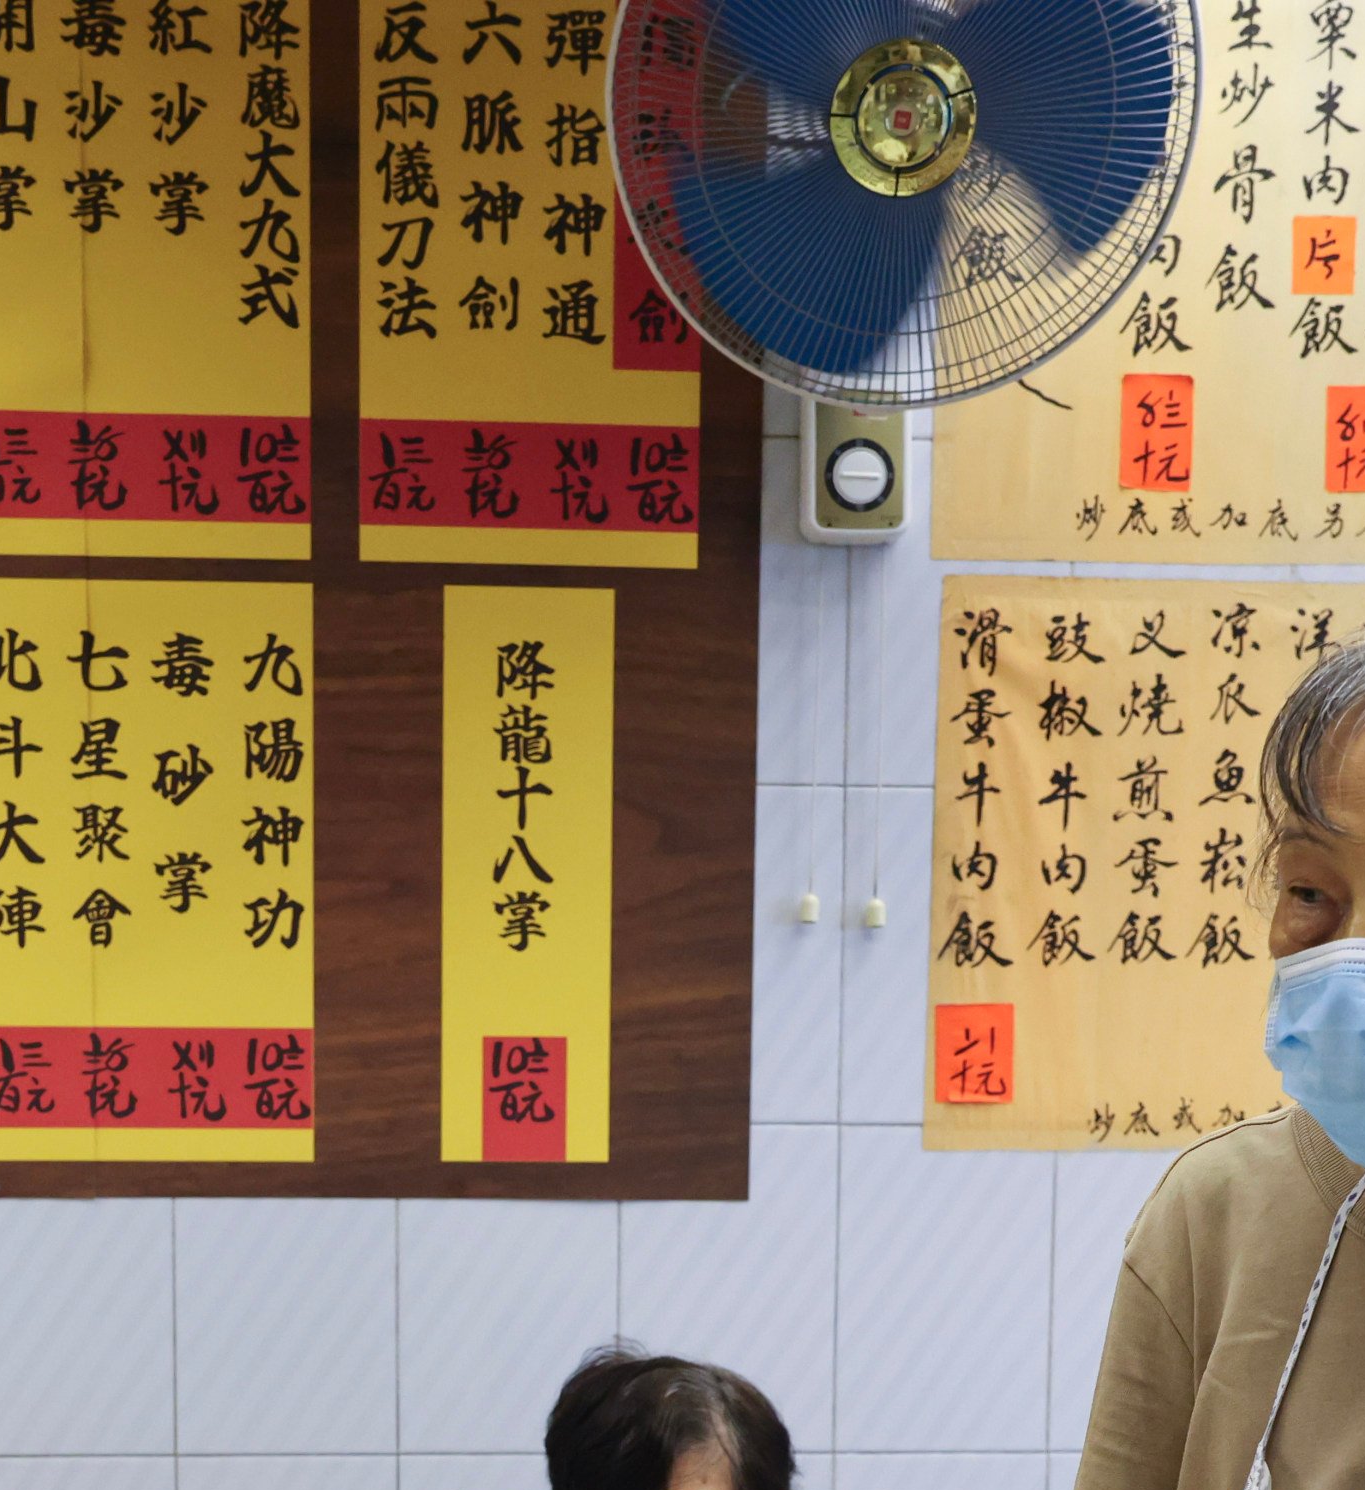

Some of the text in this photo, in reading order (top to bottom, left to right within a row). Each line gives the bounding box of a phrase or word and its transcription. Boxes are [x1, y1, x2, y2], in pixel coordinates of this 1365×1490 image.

[149, 0, 212, 236] 紅沙掌
[374, 1, 439, 339] 反兩儀刀法
[543, 10, 606, 345] 彈指神通
[67, 630, 131, 947] 七星聚會
[152, 633, 214, 913] 毒砂掌
[242, 633, 304, 949] 九陽神功
[493, 641, 554, 951] 降龍十八掌
[939, 609, 1012, 967] 滑蛋牛肉飯
[1088, 1096, 1249, 1143] 炒底或加
